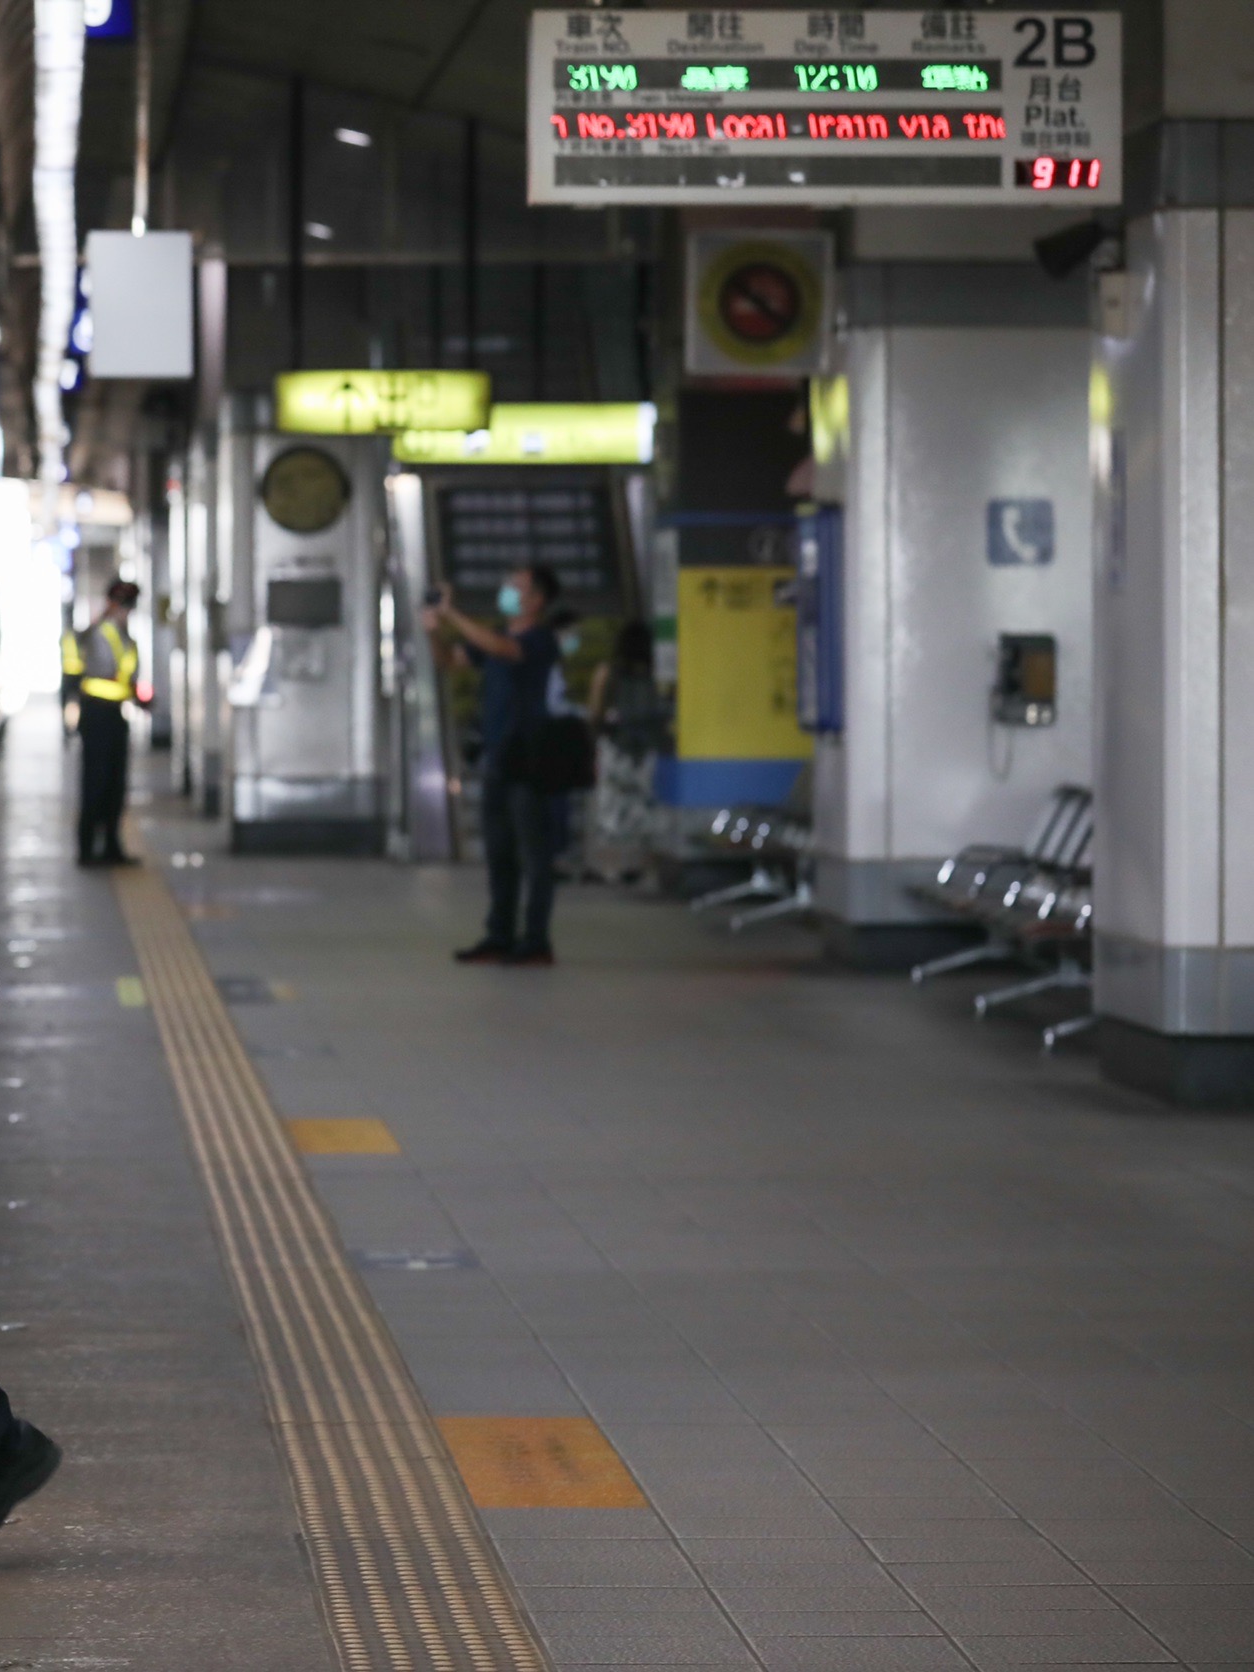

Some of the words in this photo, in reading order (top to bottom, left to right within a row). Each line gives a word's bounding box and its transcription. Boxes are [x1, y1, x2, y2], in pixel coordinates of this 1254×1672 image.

[567, 13, 624, 39] 車次
[667, 40, 764, 54] Destination
[911, 40, 986, 54] Remarks
[1013, 16, 1097, 68] 2B
[898, 112, 952, 140] via
[1025, 105, 1084, 127] Plat.
